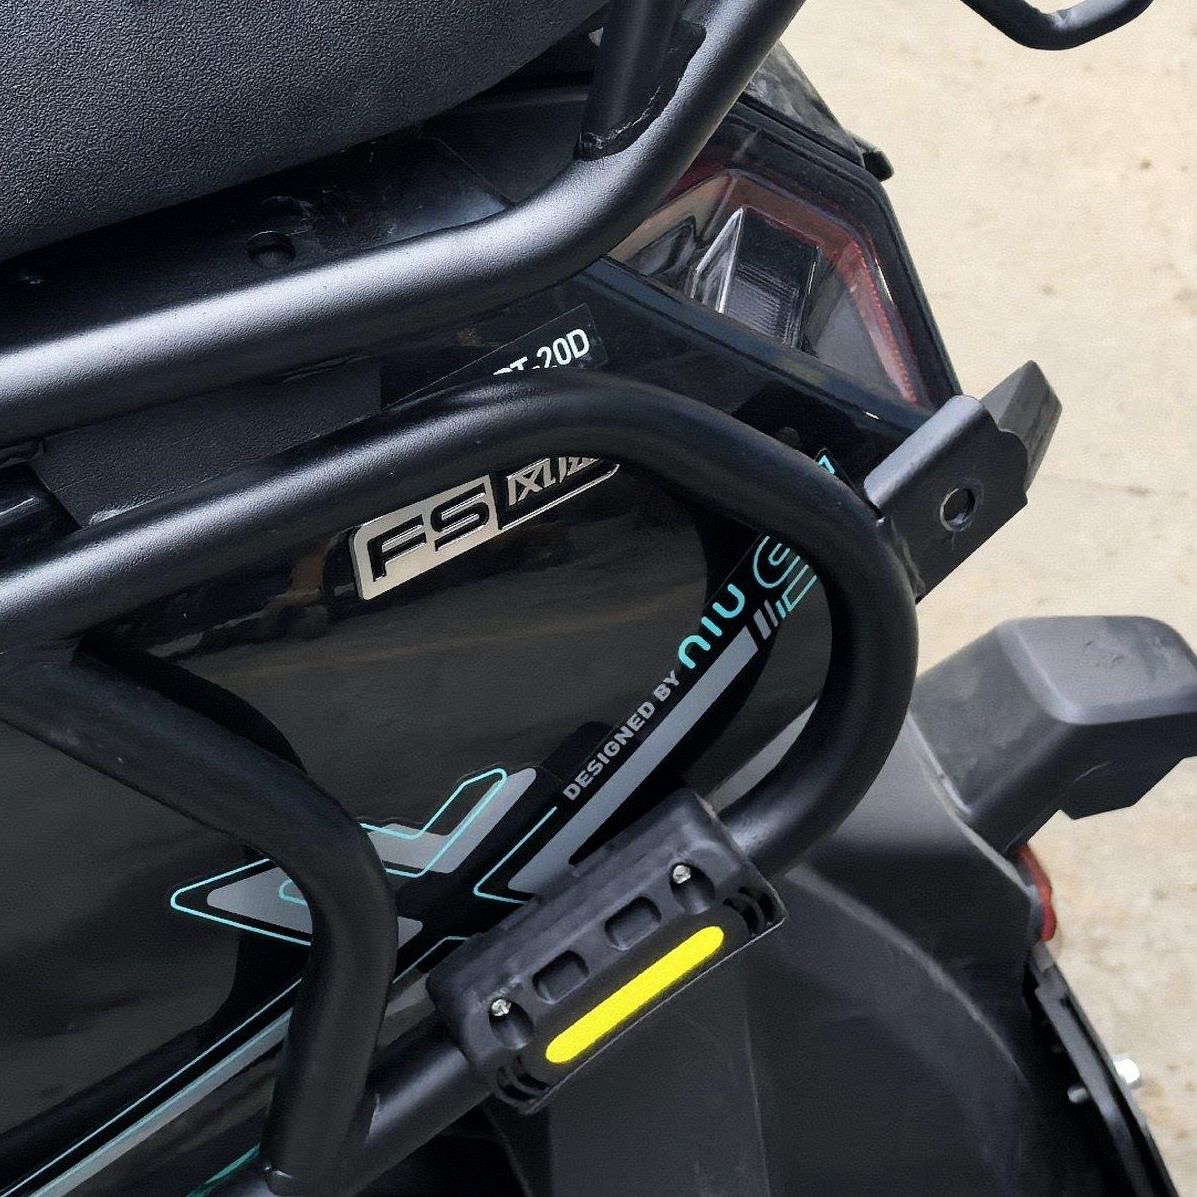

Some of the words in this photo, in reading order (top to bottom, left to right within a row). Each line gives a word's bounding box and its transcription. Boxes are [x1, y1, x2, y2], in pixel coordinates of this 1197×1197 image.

[367, 482, 491, 583] FS
[562, 701, 656, 801] DESIGNED
[652, 669, 680, 702] BY
